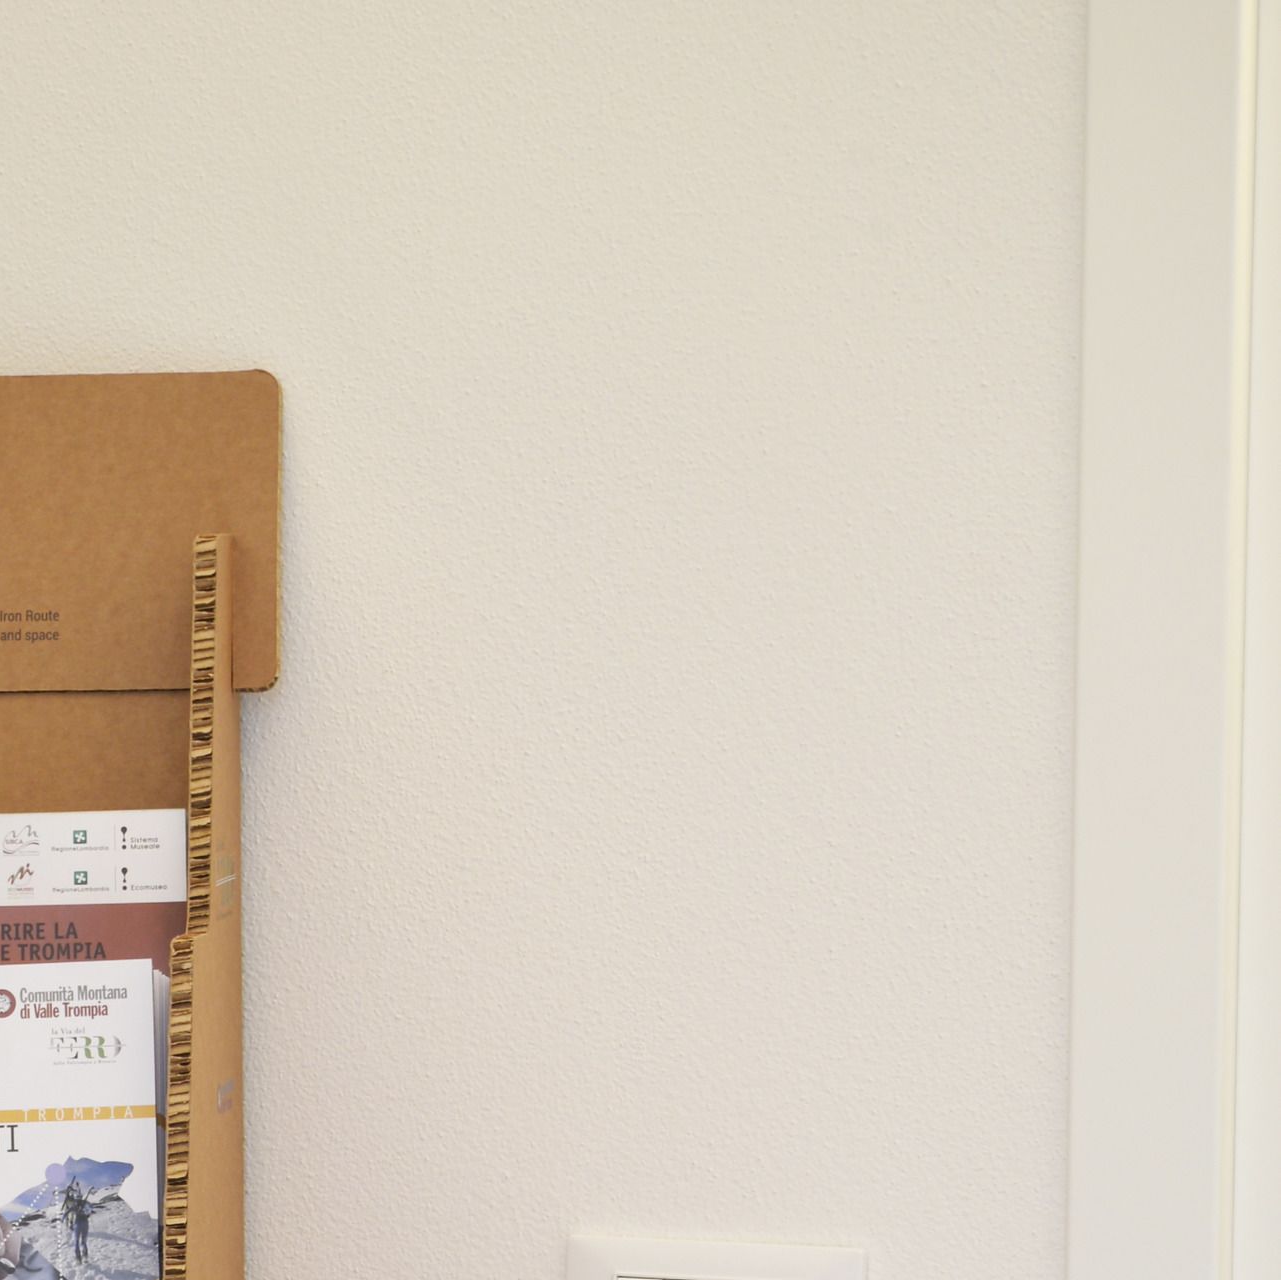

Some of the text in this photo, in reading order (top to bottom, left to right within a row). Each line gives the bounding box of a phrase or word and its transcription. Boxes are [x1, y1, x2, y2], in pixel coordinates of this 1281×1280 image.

[0, 610, 21, 622] Iron
[26, 610, 59, 621] Route
[1, 629, 21, 641] and
[25, 630, 59, 643] space
[54, 922, 78, 940] LA
[18, 943, 107, 961] TROMPIA
[20, 985, 127, 1003] Comunità Montana
[20, 1001, 108, 1019] di Valle Trompia
[23, 1106, 134, 1122] TROMPIA
